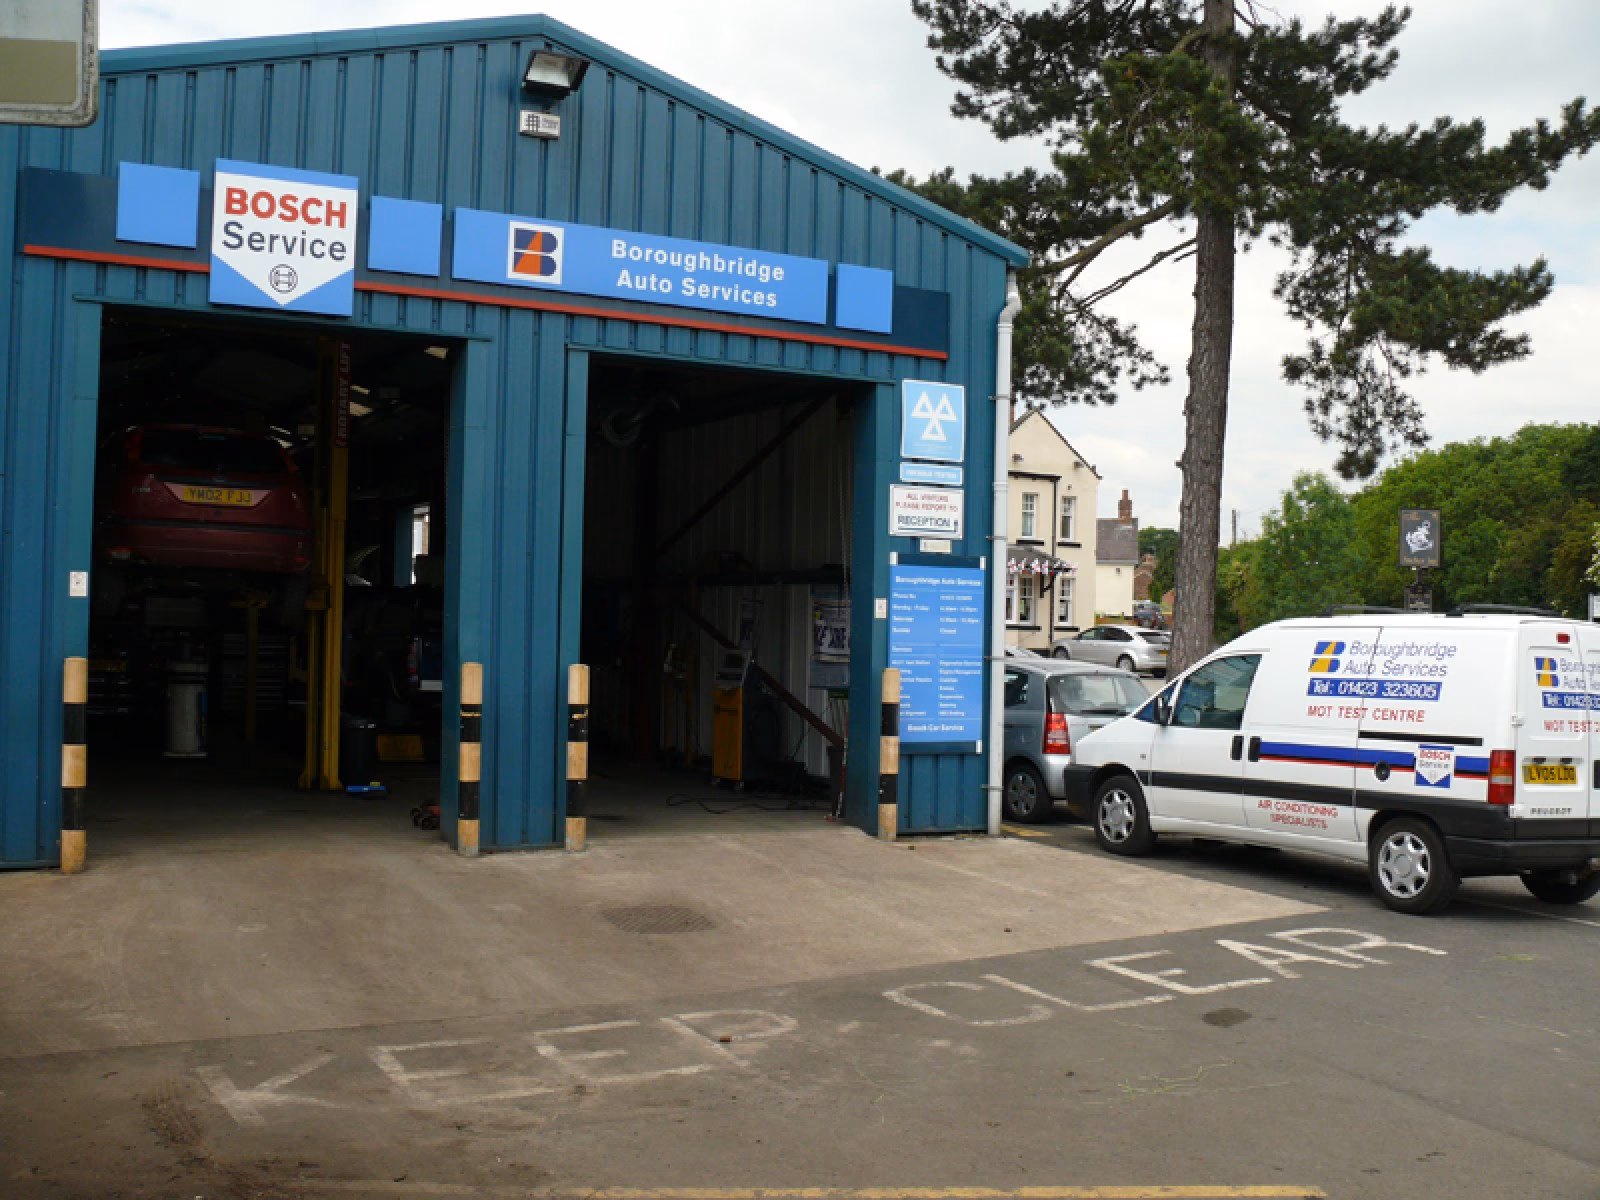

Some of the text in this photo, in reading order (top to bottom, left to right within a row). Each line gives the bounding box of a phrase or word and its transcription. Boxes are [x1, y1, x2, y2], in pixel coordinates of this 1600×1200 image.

[225, 186, 347, 229] BOSCH
[222, 220, 347, 261] Service
[611, 238, 785, 282] Boroughbridge
[617, 269, 777, 307] Auto Services
[896, 501, 919, 510] PLEASE
[921, 503, 947, 512] REPORT
[897, 514, 951, 528] RECEPTION
[1350, 639, 1457, 661] Boroughbridge
[1342, 659, 1448, 677] Auto Services
[1313, 680, 1333, 694] Tel:
[1337, 681, 1378, 696] 01423
[1306, 705, 1425, 722] MOT TEST CENTRE
[1568, 719, 1592, 732] TEST
[1258, 799, 1338, 818] AIR CONDITIONING
[194, 926, 1450, 1129] KEEP CLEAR
